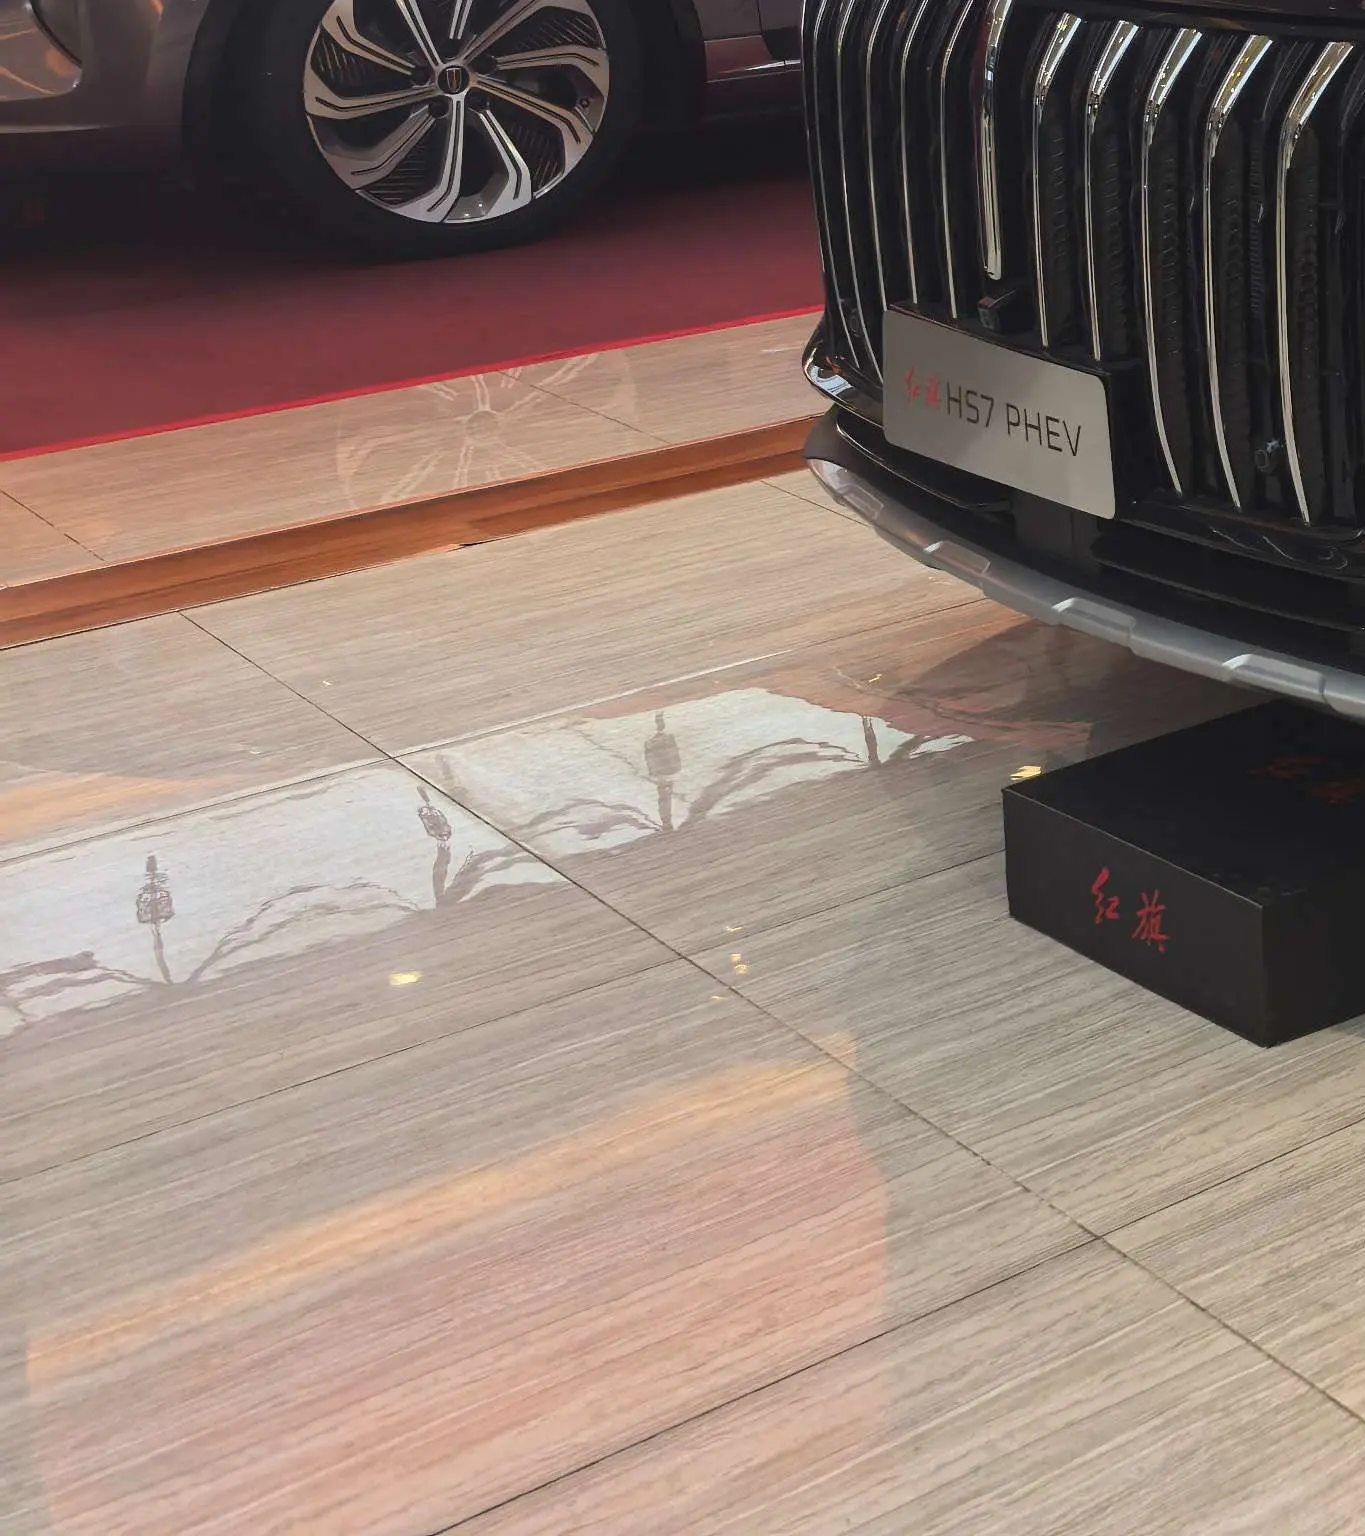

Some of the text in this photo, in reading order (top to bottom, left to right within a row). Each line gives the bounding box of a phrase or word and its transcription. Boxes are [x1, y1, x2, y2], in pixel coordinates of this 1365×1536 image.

[945, 381, 995, 429] HS7
[1005, 403, 1082, 457] PHEV
[1091, 866, 1170, 954] 红旗
